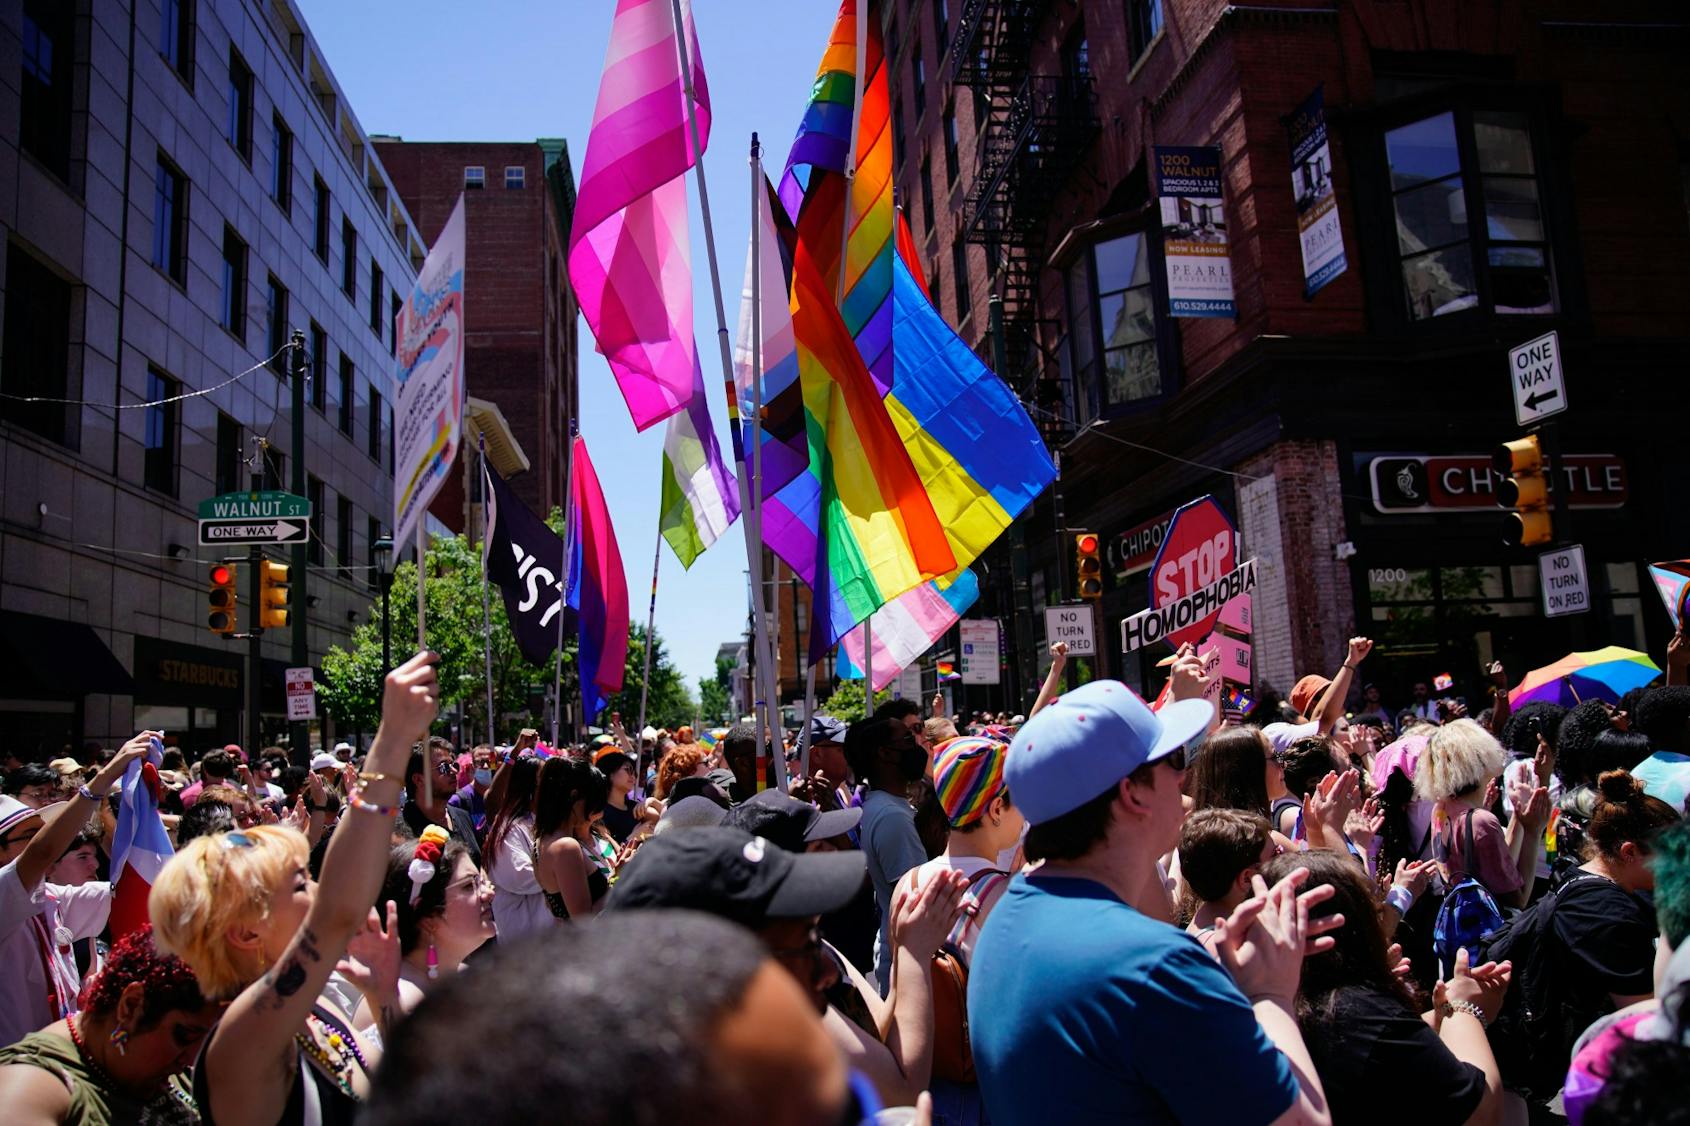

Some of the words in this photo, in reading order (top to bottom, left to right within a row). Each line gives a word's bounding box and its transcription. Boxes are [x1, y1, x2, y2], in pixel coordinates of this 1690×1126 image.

[1160, 155, 1190, 166] 1200
[1162, 166, 1217, 177] WALNUT
[1162, 178, 1196, 186] SPACIOUS
[1163, 185, 1199, 193] BEDROOM
[1172, 264, 1229, 277] PEARL
[1173, 302, 1231, 311] 610.529.4444
[1517, 341, 1552, 369] ONE
[1519, 362, 1553, 390] WAY
[1443, 466, 1625, 494] CHTLE
[214, 501, 281, 517] WALNUT
[289, 505, 301, 515] ST
[213, 527, 241, 537] ONE
[246, 526, 277, 536] WAY
[1121, 520, 1169, 560] CHIPOT
[1157, 530, 1230, 607] STOP
[1553, 556, 1570, 570] NO
[1368, 568, 1407, 583] 1200
[1549, 573, 1579, 589] TURN
[1124, 562, 1257, 651] HOMOPHOBIA
[1548, 595, 1563, 608] ON
[1565, 591, 1584, 607] RED
[1060, 612, 1077, 622] NO
[1056, 626, 1084, 636] TURN
[1070, 640, 1090, 650] RED
[160, 660, 240, 688] STARBUCKS
